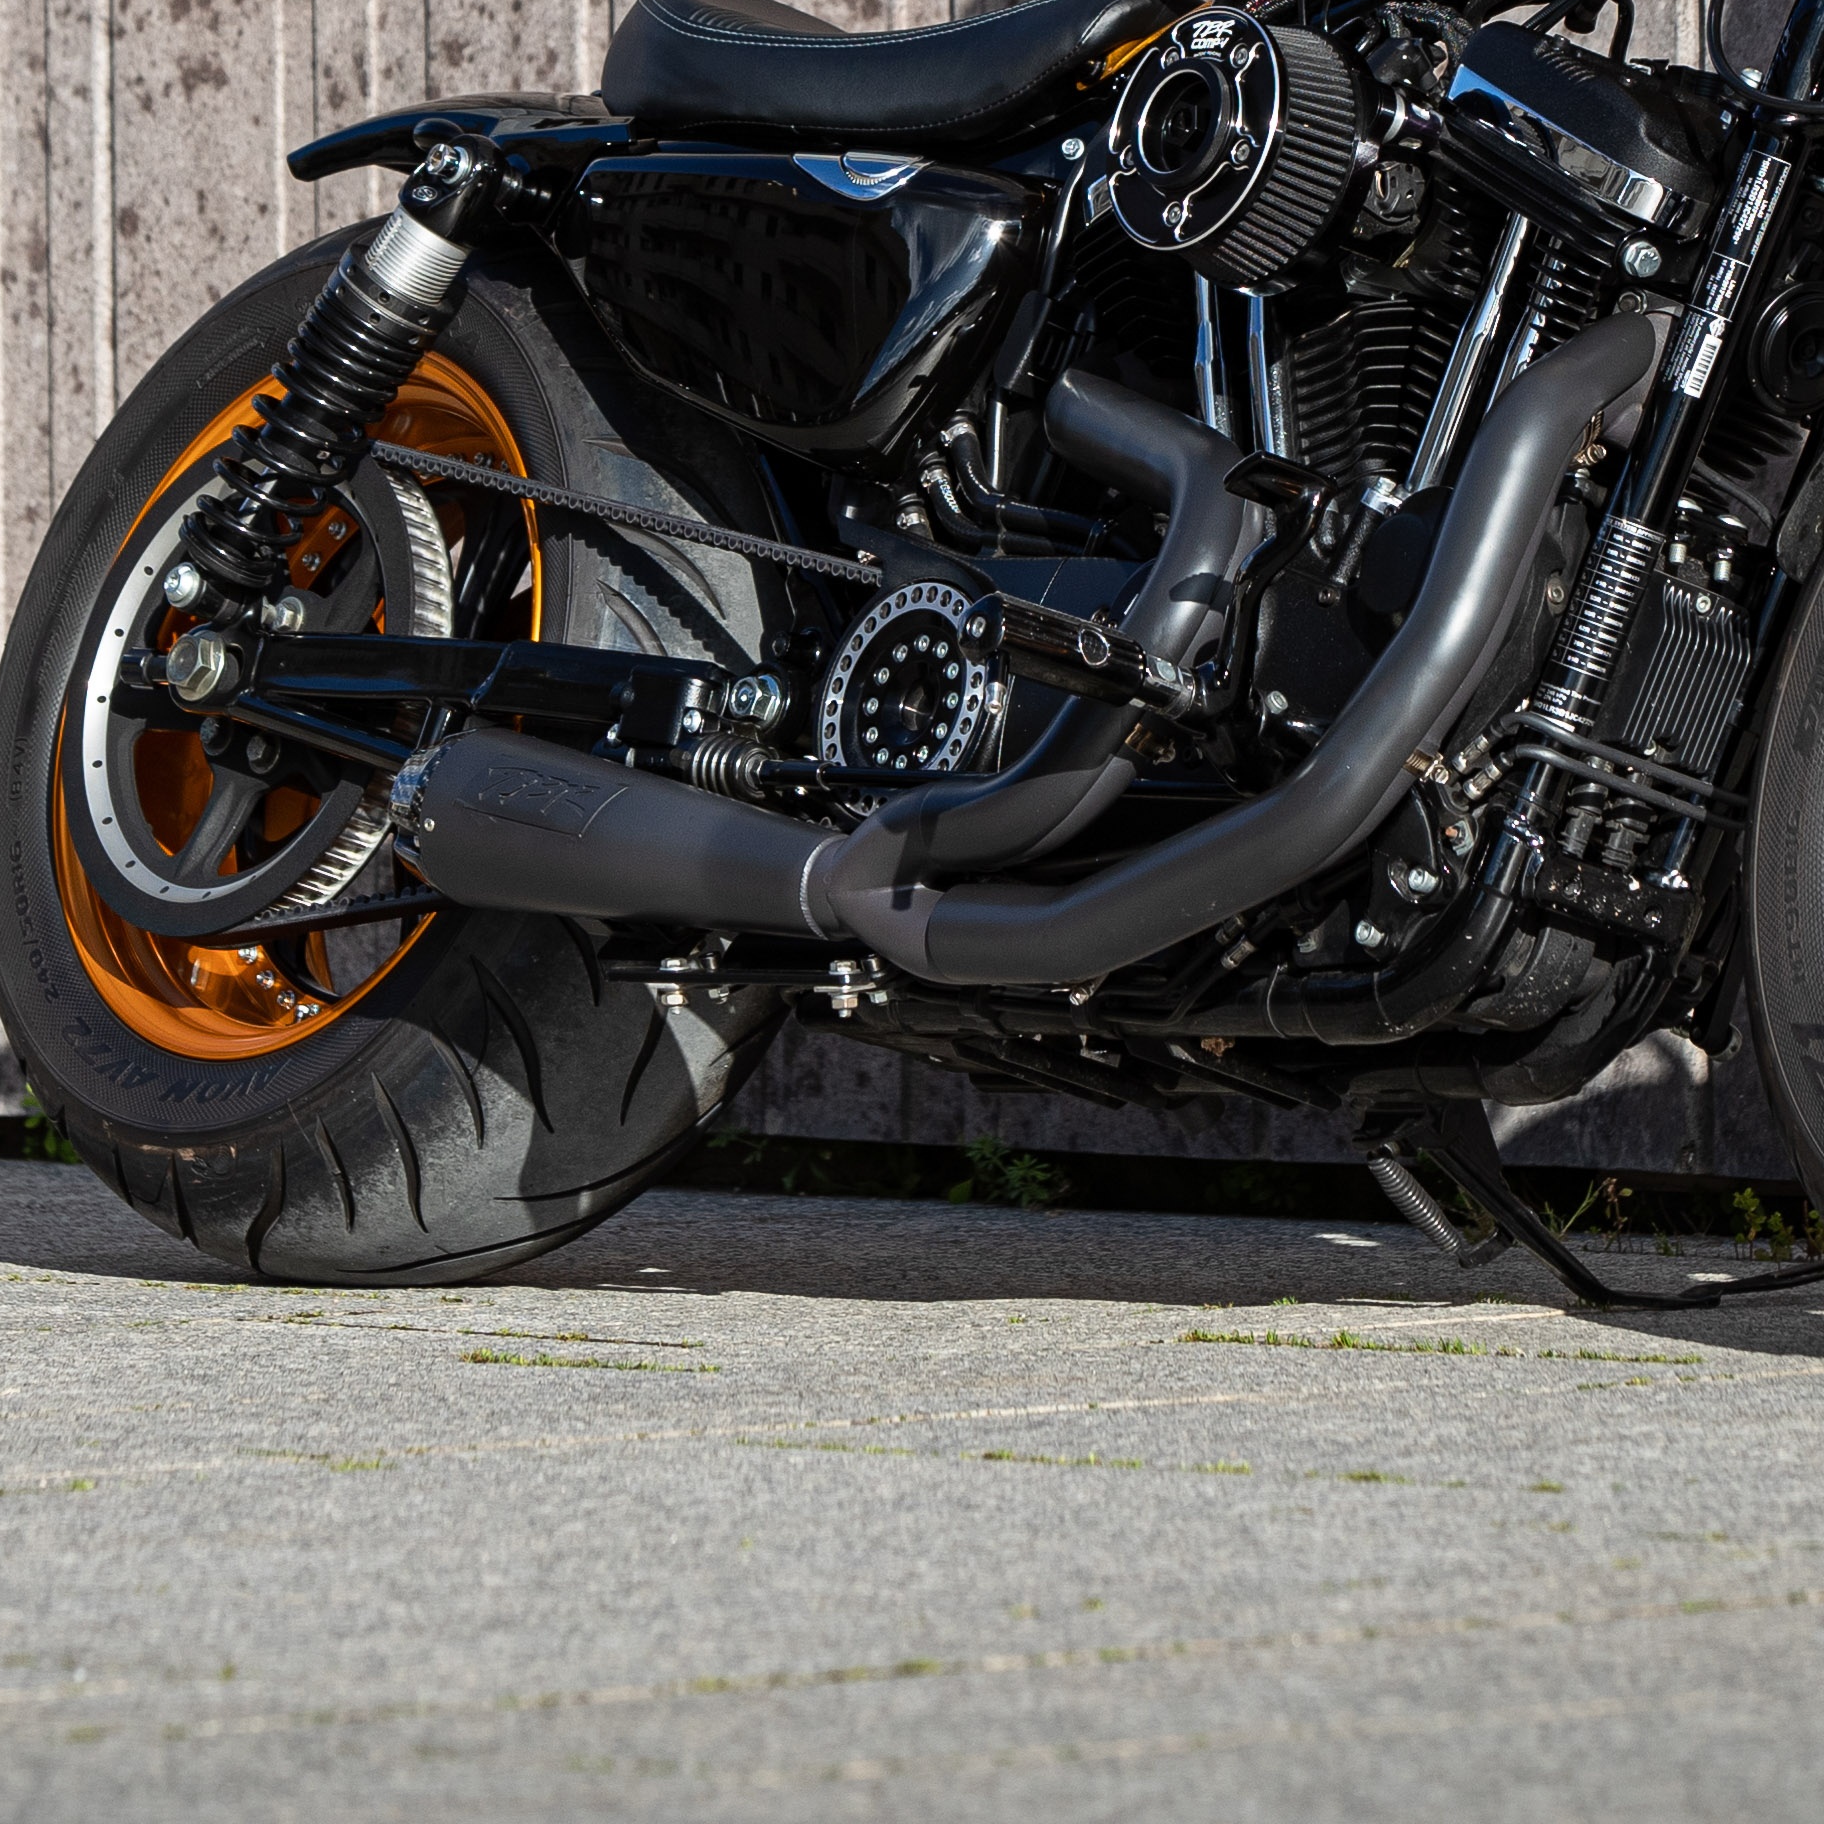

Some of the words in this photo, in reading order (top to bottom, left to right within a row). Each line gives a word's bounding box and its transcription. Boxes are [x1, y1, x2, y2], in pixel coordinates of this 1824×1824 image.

[9, 840, 60, 1004] 240/50R16
[62, 1016, 160, 1090] AV72
[159, 1060, 288, 1105] AVON
